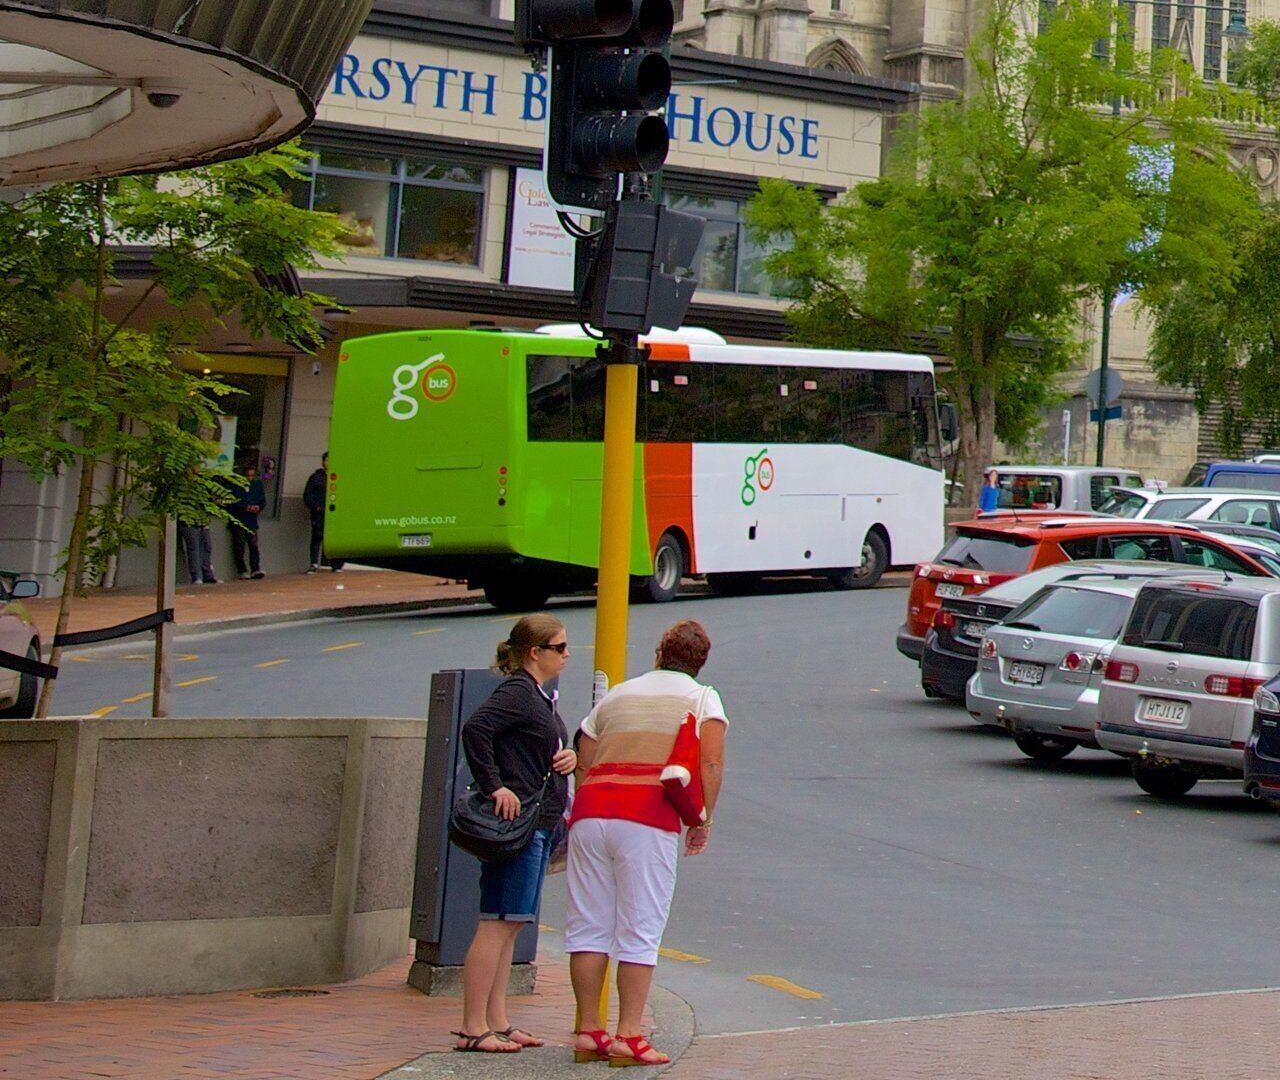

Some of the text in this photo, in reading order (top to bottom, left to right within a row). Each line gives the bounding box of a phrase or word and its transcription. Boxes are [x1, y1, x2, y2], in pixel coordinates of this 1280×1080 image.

[668, 93, 819, 159] HOUSE
[429, 377, 449, 389] bus
[374, 515, 457, 528] www.gobus.co.nz
[1147, 703, 1185, 720] HTJ112
